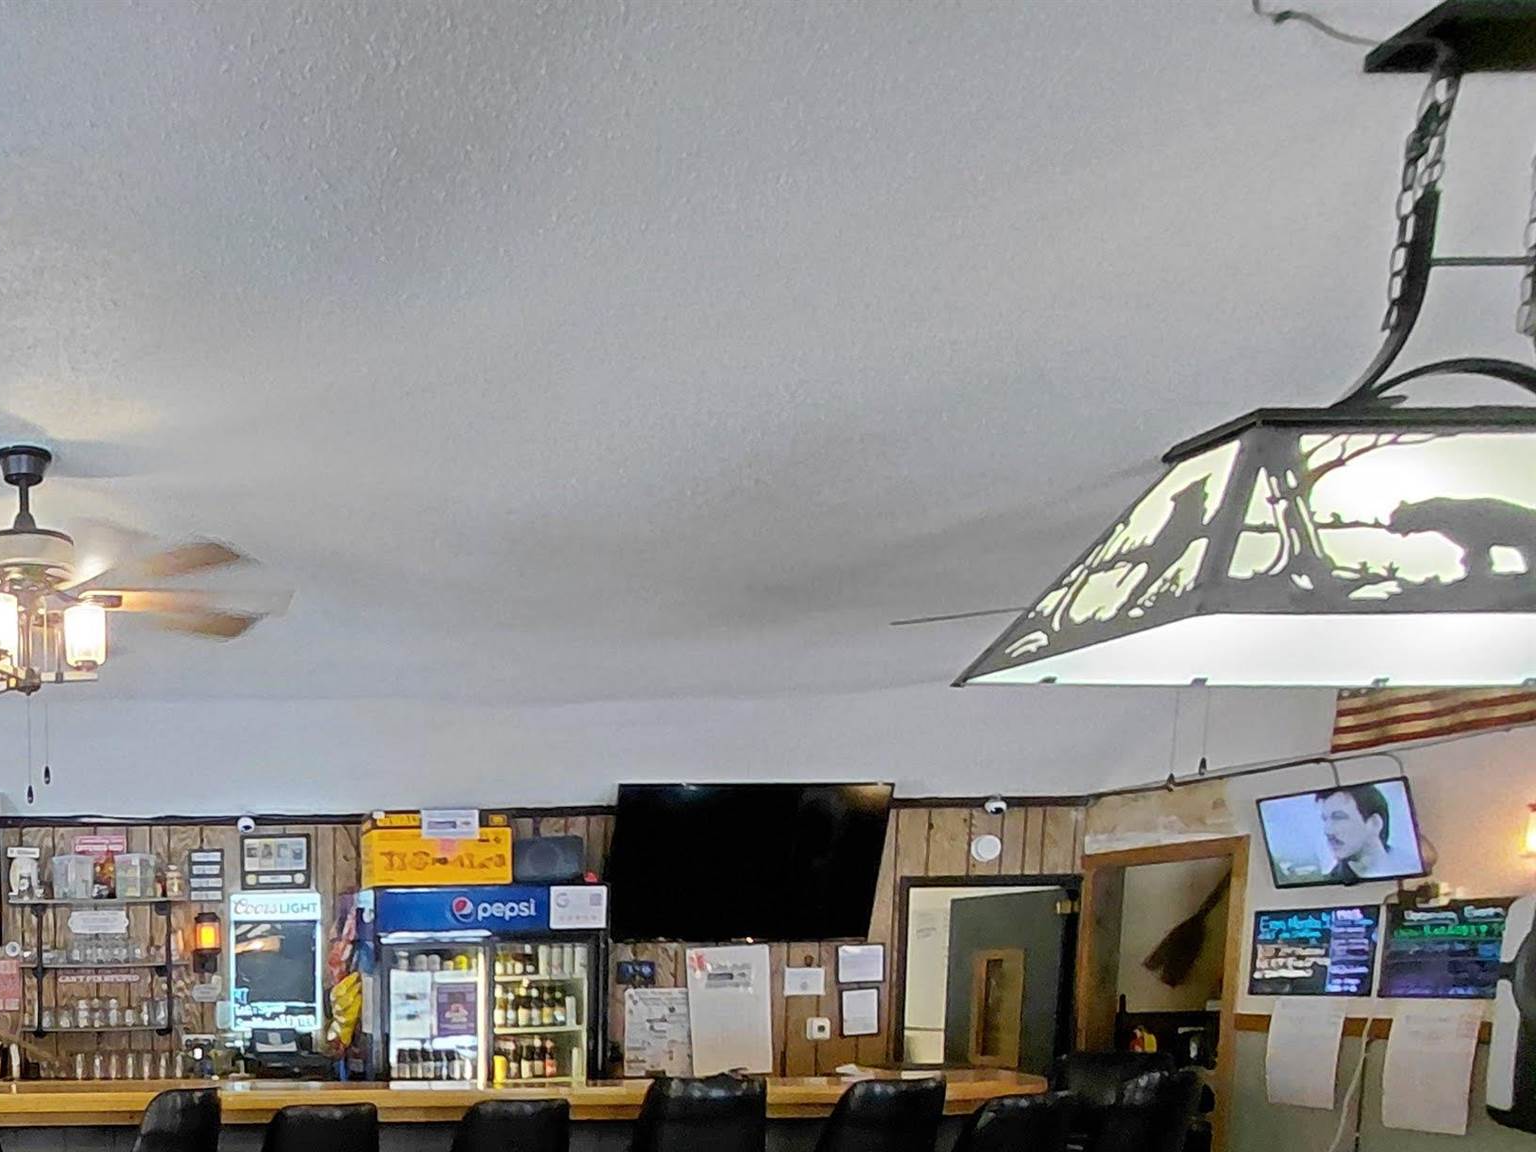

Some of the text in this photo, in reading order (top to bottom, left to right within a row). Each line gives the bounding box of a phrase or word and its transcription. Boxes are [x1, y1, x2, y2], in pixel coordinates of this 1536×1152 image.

[233, 898, 318, 915] Coors LIGHT
[477, 898, 537, 922] pepsi
